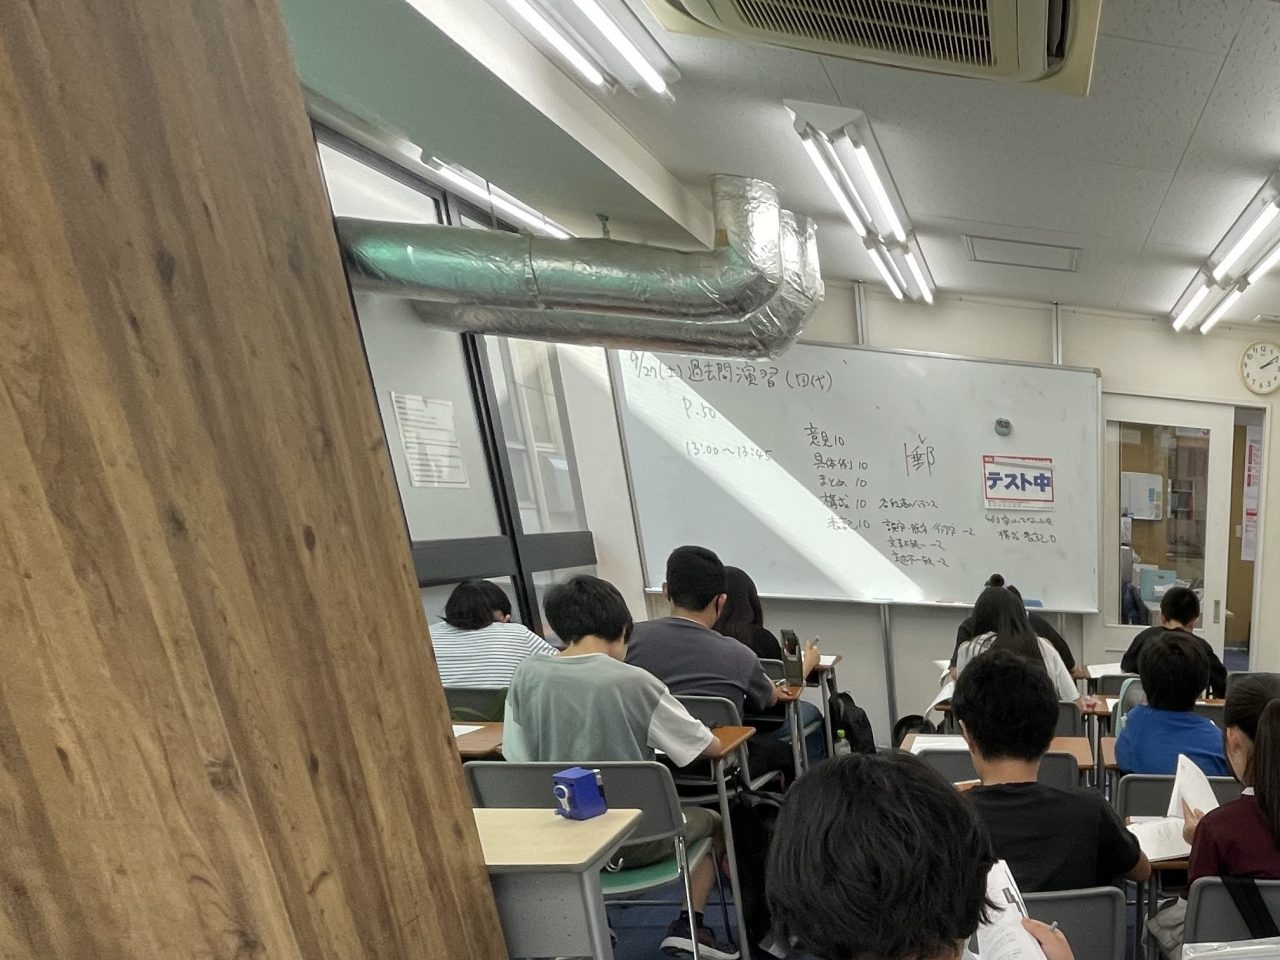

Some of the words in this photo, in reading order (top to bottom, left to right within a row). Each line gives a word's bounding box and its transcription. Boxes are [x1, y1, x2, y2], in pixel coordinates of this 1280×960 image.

[688, 359, 779, 388] 過去問演習
[986, 471, 1052, 493] テスト中
